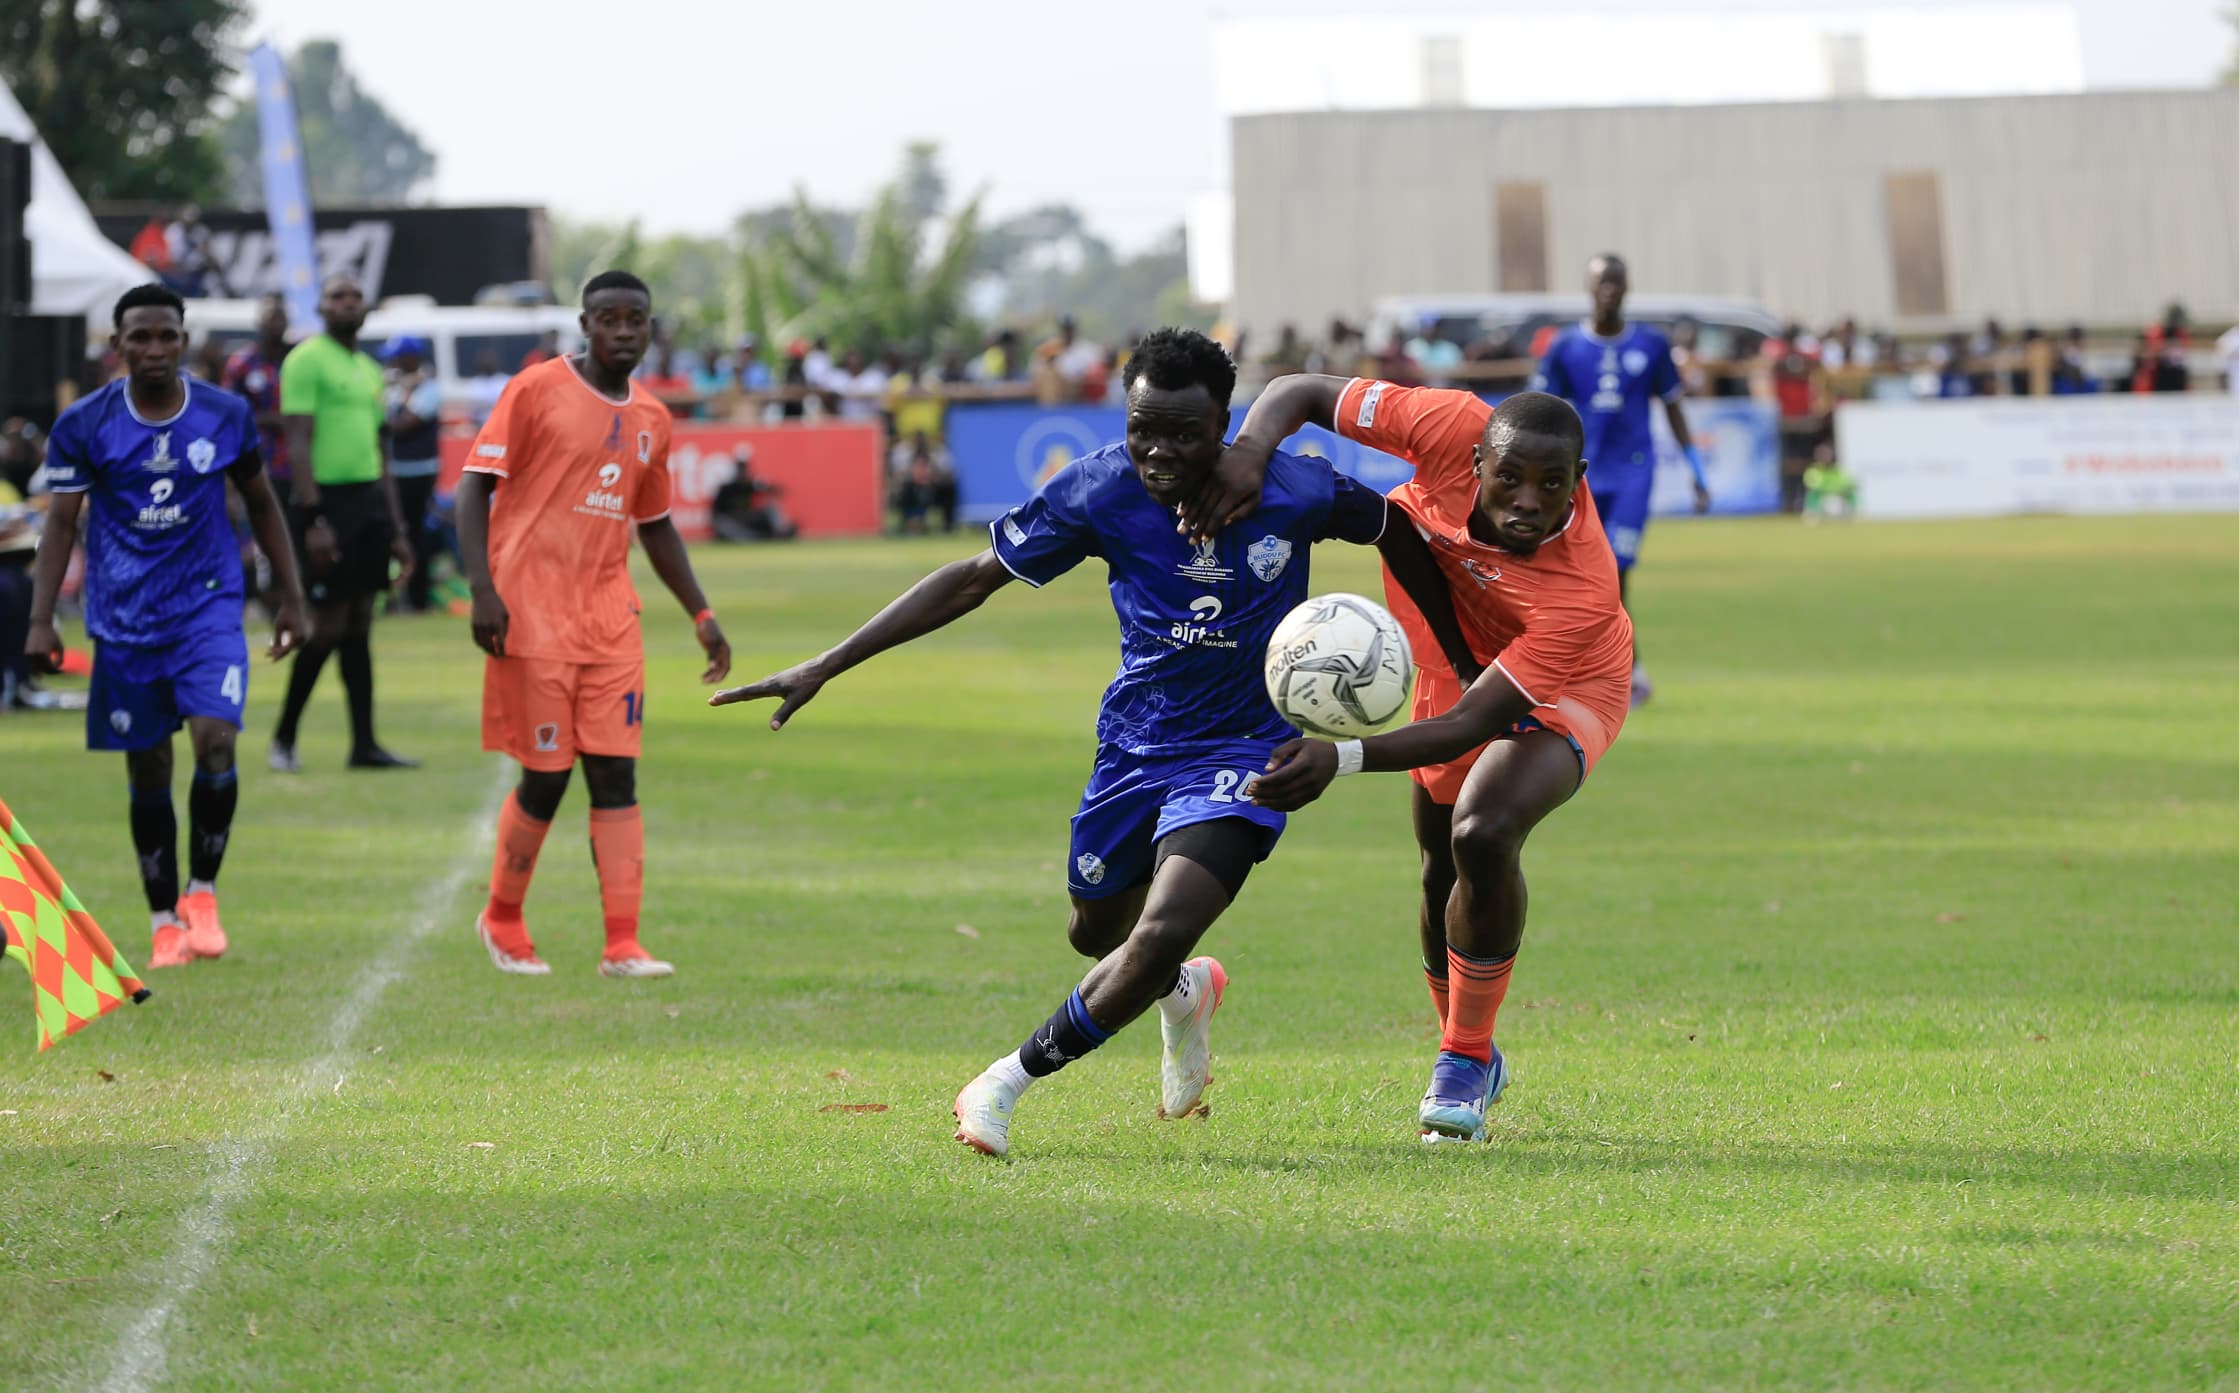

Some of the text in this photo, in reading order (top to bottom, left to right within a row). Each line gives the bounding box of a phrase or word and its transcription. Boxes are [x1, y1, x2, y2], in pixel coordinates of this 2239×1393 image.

[1253, 552, 1278, 561] BUDDU
[1202, 640, 1238, 648] IMAGINE
[1269, 639, 1318, 684] molten
[220, 664, 242, 706] 4
